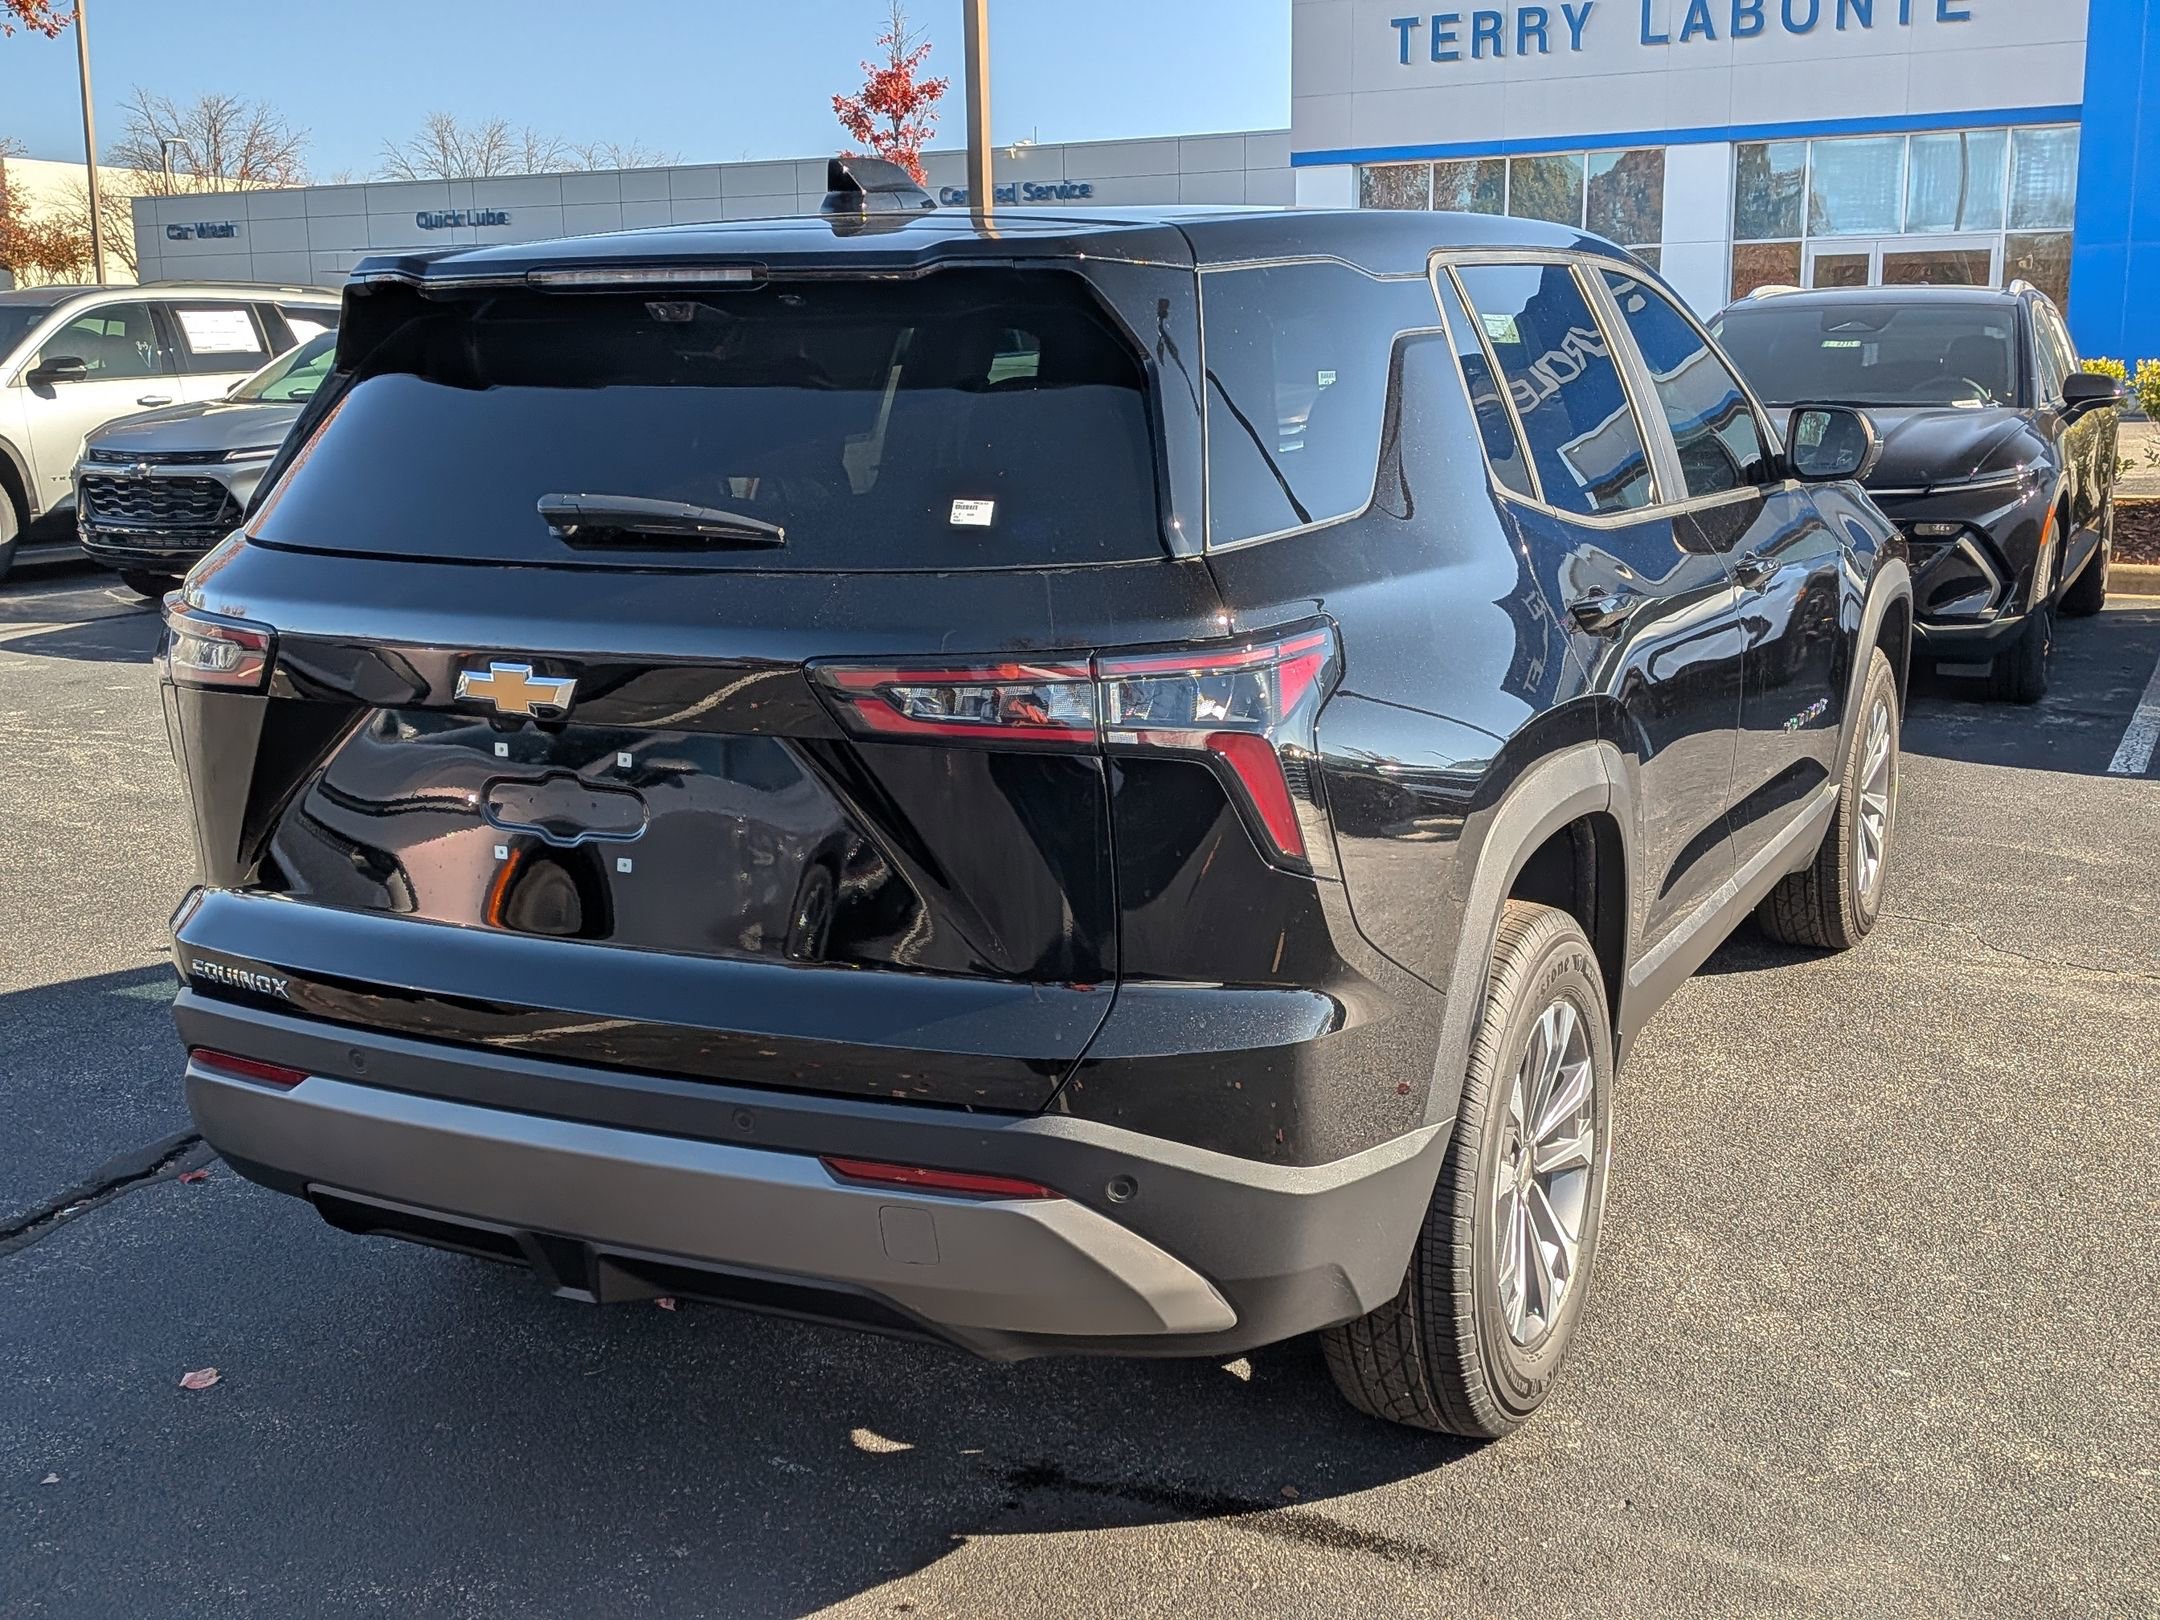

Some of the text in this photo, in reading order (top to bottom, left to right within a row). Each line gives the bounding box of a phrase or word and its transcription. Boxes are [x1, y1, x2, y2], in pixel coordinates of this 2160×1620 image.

[1390, 1, 1594, 65] TERRY
[939, 180, 1094, 206] Cered Service
[166, 220, 240, 240] Car Wash
[416, 207, 512, 230] Quick Lube
[192, 958, 290, 999] EQUINOX
